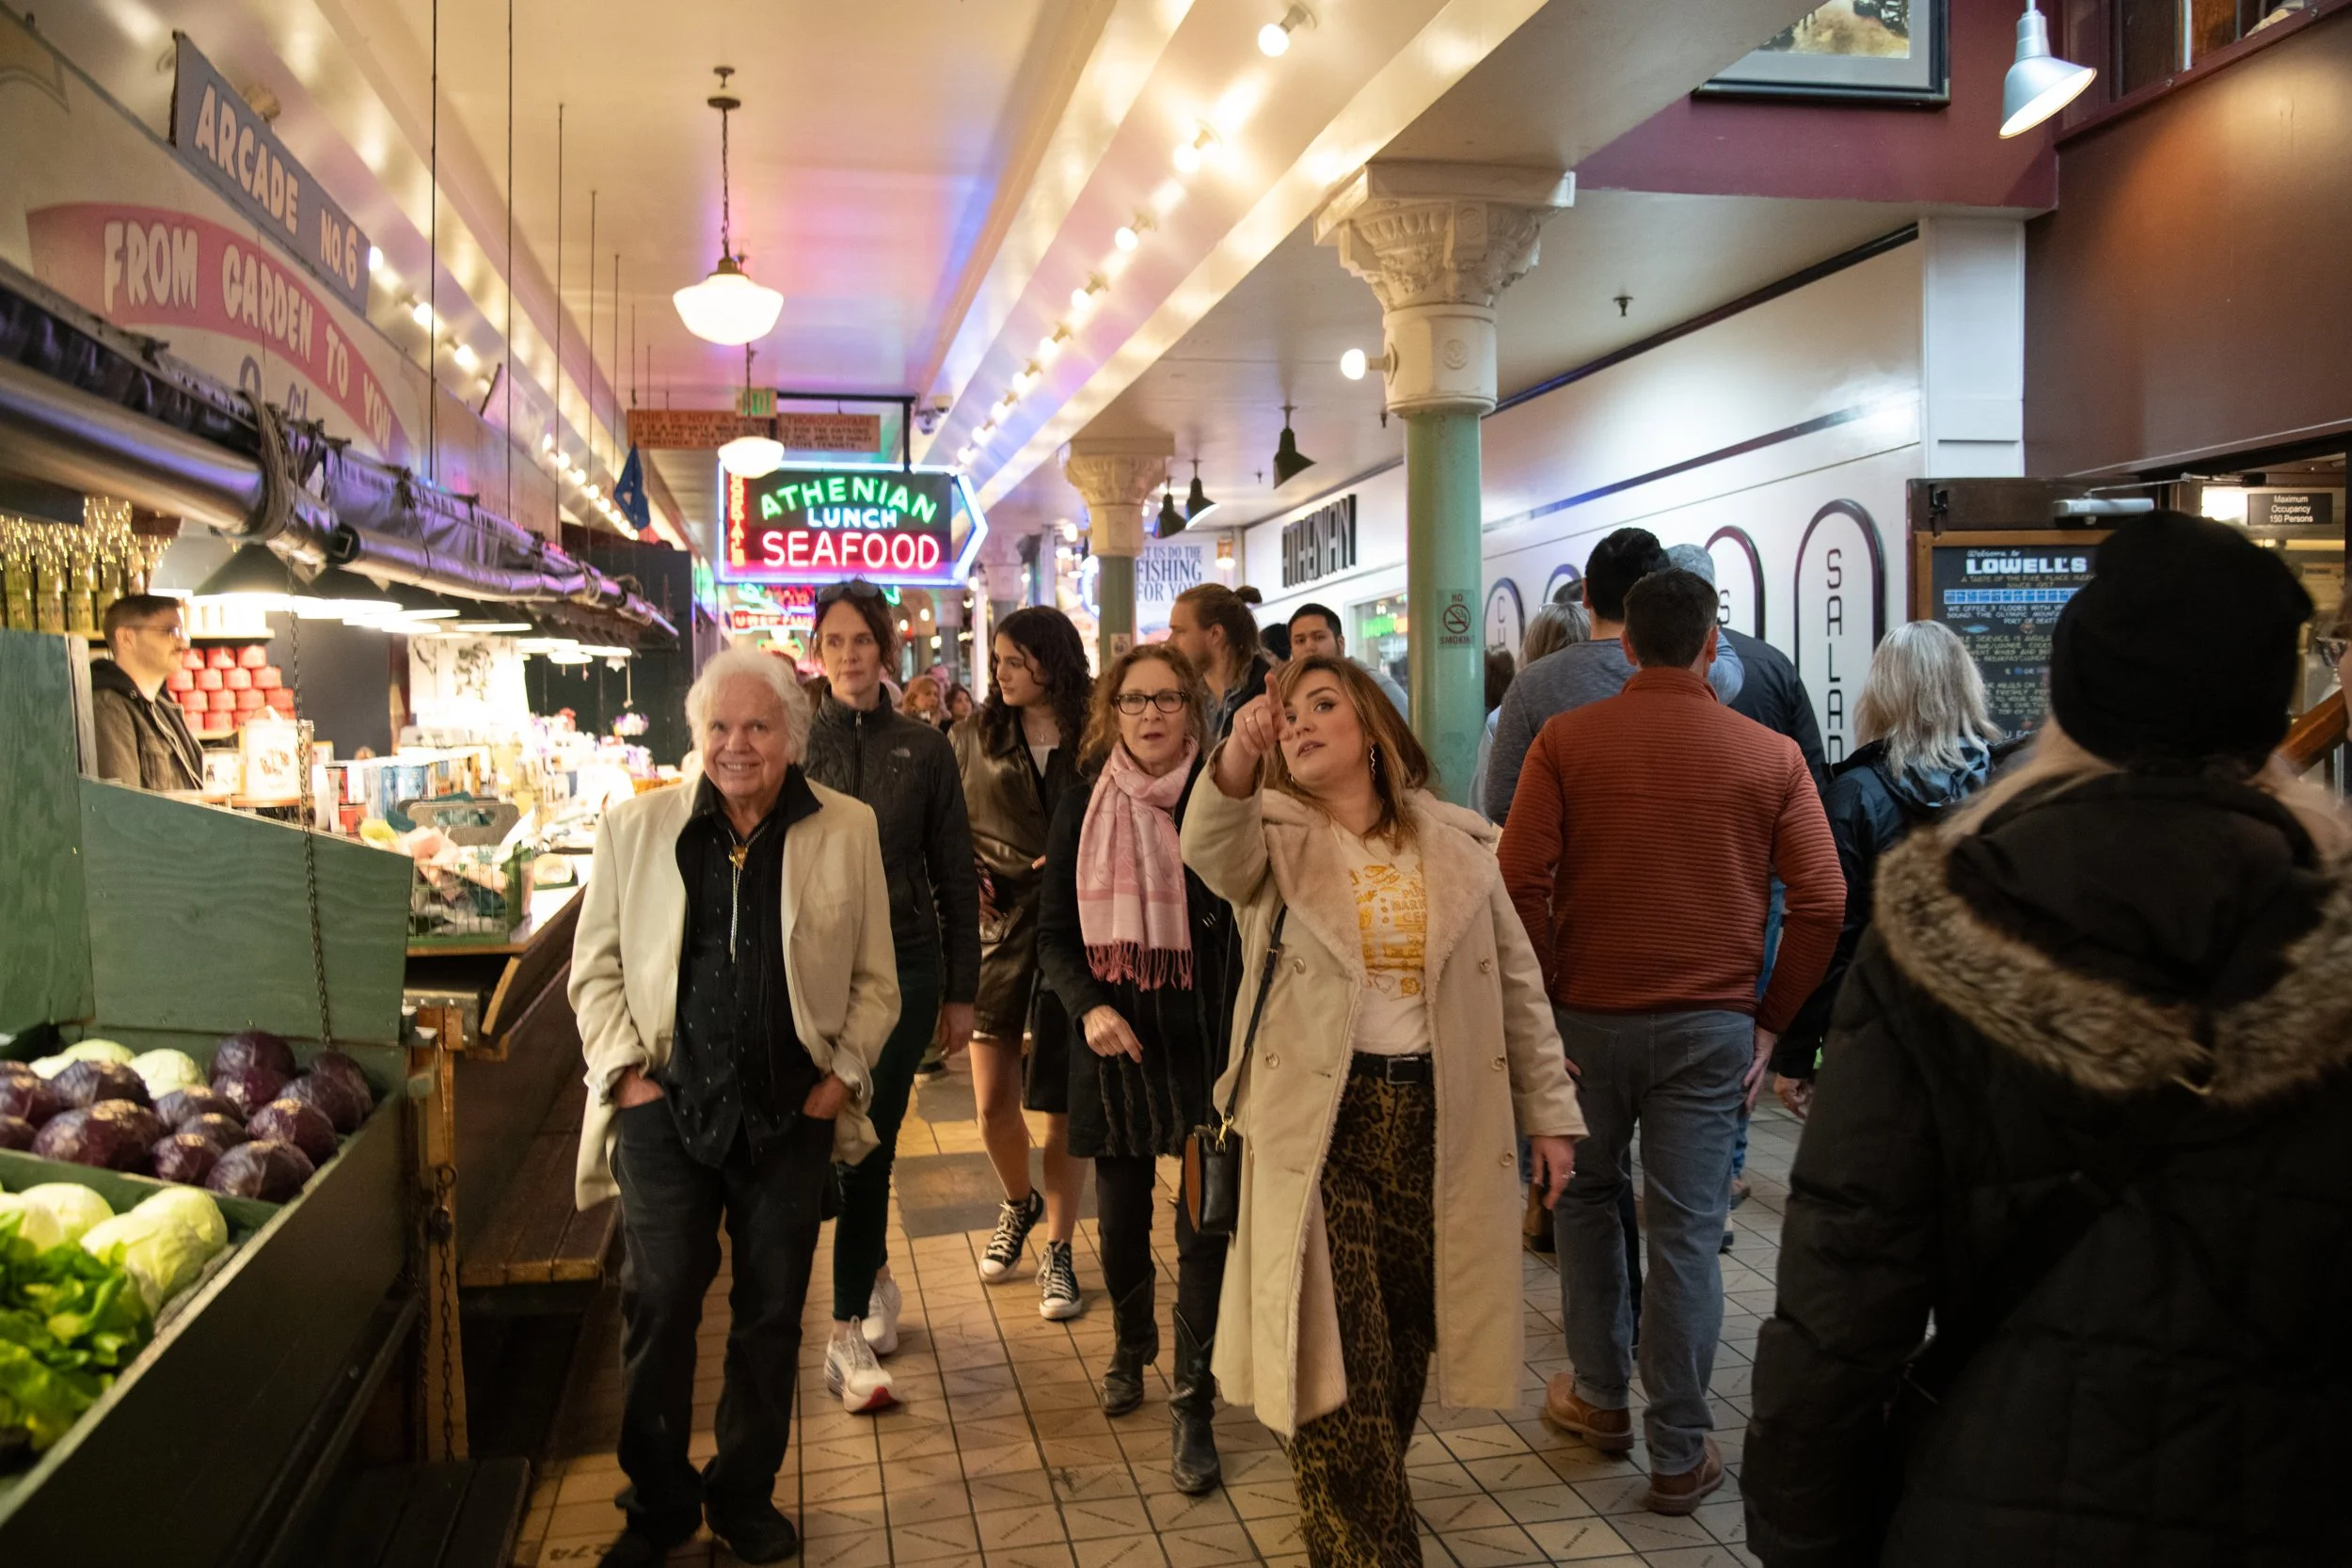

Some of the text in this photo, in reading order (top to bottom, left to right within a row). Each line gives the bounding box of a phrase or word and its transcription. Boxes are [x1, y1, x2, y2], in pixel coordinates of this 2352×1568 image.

[194, 83, 299, 236] ARCADE
[103, 220, 199, 316] FROM
[222, 245, 314, 364] GARDEN
[326, 323, 349, 400] TO
[363, 372, 391, 455] YOU
[742, 390, 771, 415] EXIT
[637, 413, 664, 422] THIS
[669, 414, 680, 422] IS
[687, 414, 713, 423] NOT
[720, 414, 729, 423] A
[788, 416, 871, 426] THOROUGHFARE
[759, 476, 937, 524] ATHENIAN
[2273, 495, 2309, 503] Maximum
[807, 508, 898, 529] LUNCH
[2269, 515, 2313, 523] 150 Persons
[2271, 505, 2311, 515] Occupancy
[761, 530, 940, 570] SEAFOOD
[1282, 494, 1357, 589] ATHENIAN
[1153, 546, 1166, 559] US
[1168, 546, 1182, 559] DO
[1185, 546, 1201, 559] THE
[1136, 559, 1202, 581] FISHING
[1965, 557, 2088, 575] LOWELL'S
[1136, 582, 1164, 602] FOR
[1451, 594, 1463, 603] NO
